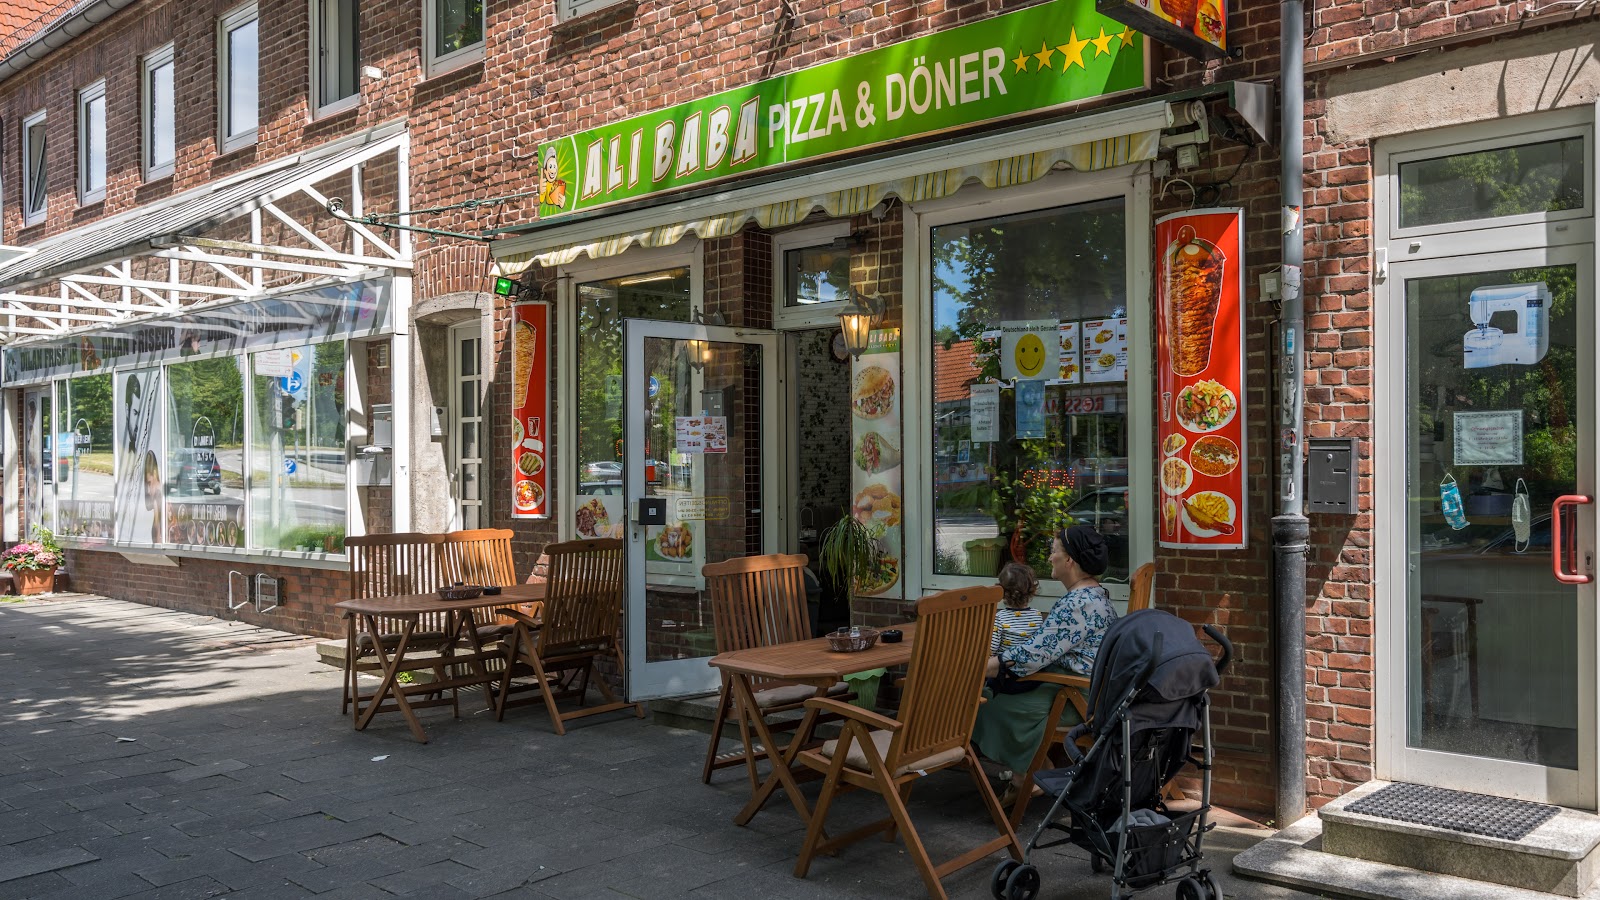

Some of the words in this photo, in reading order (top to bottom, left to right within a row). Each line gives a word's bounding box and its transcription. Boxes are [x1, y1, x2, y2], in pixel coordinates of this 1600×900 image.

[581, 129, 643, 201] ALI
[652, 95, 760, 184] BABA
[769, 89, 847, 149] PIZZA
[855, 81, 876, 128] &
[886, 46, 1008, 122] DÖNER
[102, 337, 129, 359] DILAN
[132, 326, 176, 354] FRISEUR
[878, 332, 898, 343] BABA
[20, 350, 42, 372] DILAN
[44, 343, 79, 369] FRISEUR
[1022, 469, 1075, 488] OPEN
